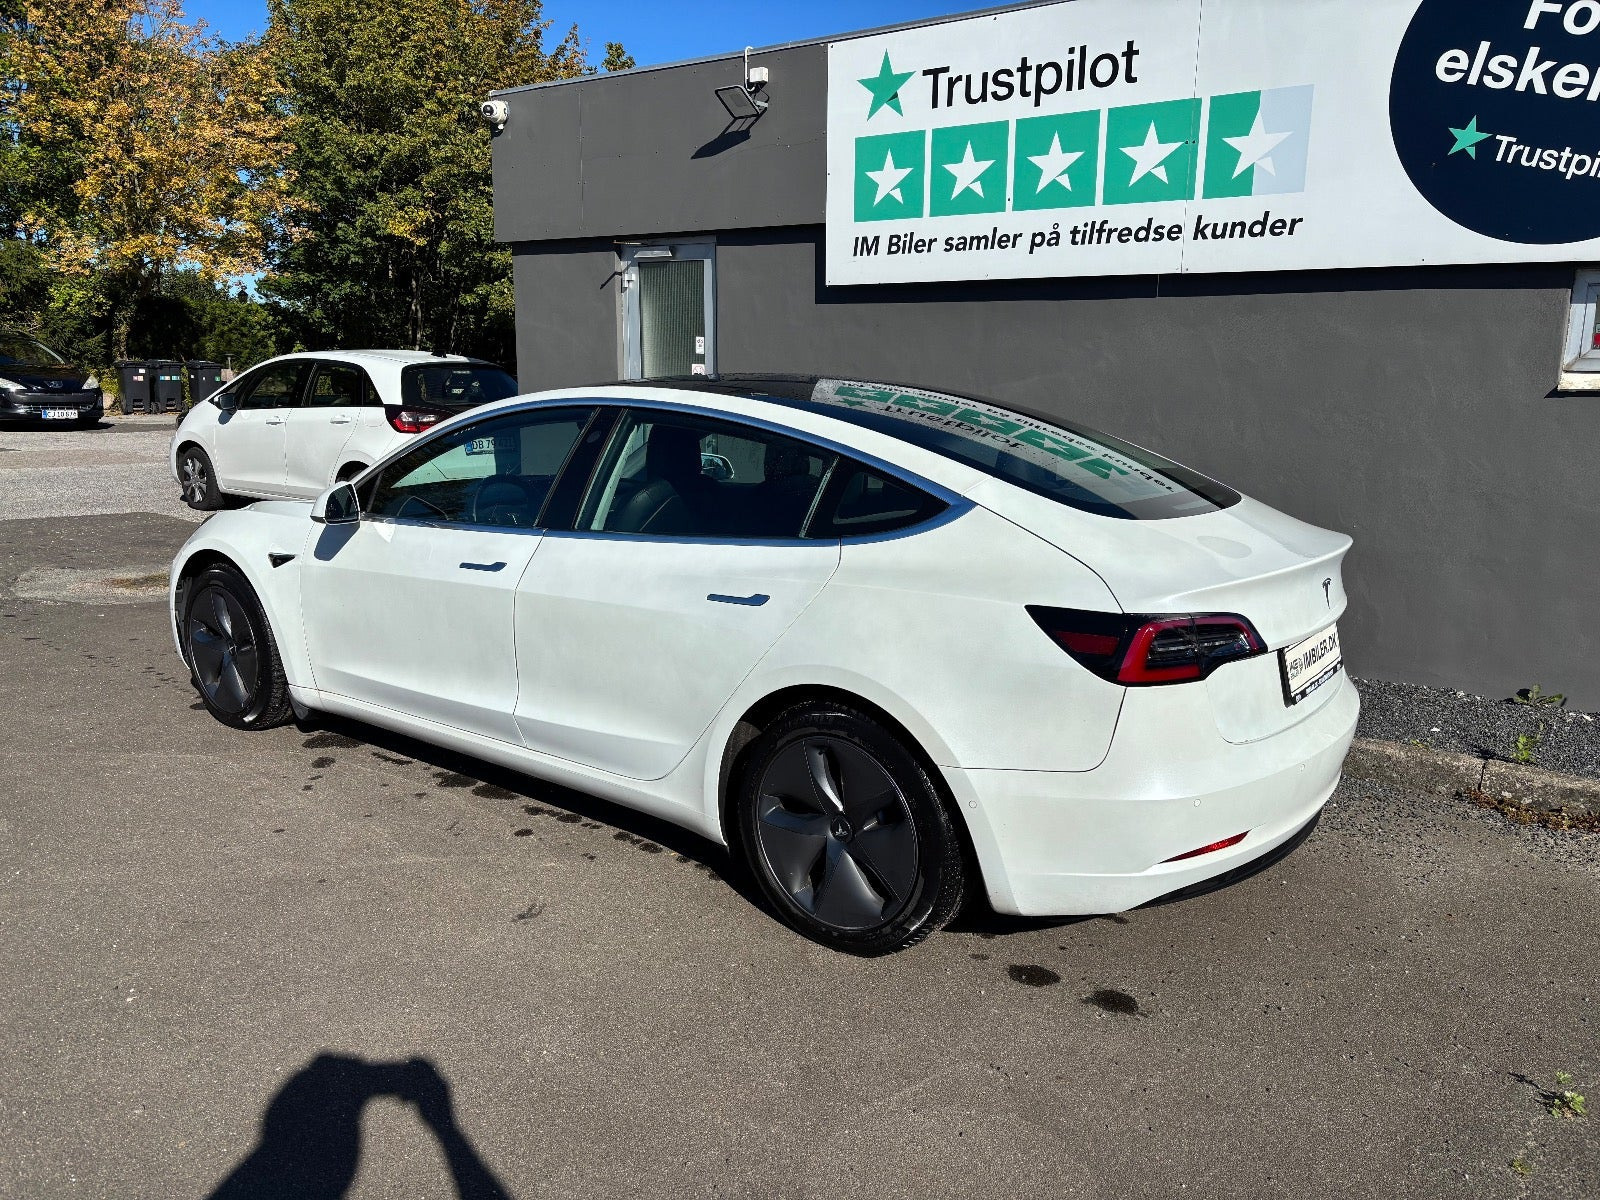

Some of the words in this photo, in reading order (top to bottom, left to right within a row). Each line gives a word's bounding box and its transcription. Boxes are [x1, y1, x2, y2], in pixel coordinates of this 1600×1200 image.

[922, 40, 1139, 109] Trustpilot
[1495, 134, 1600, 180] Trustpi
[853, 235, 880, 256] IM
[887, 232, 937, 255] Biler
[943, 227, 1023, 252] samler
[1029, 223, 1061, 254] på
[1070, 217, 1183, 246] tilfredse
[1192, 211, 1303, 240] kunder
